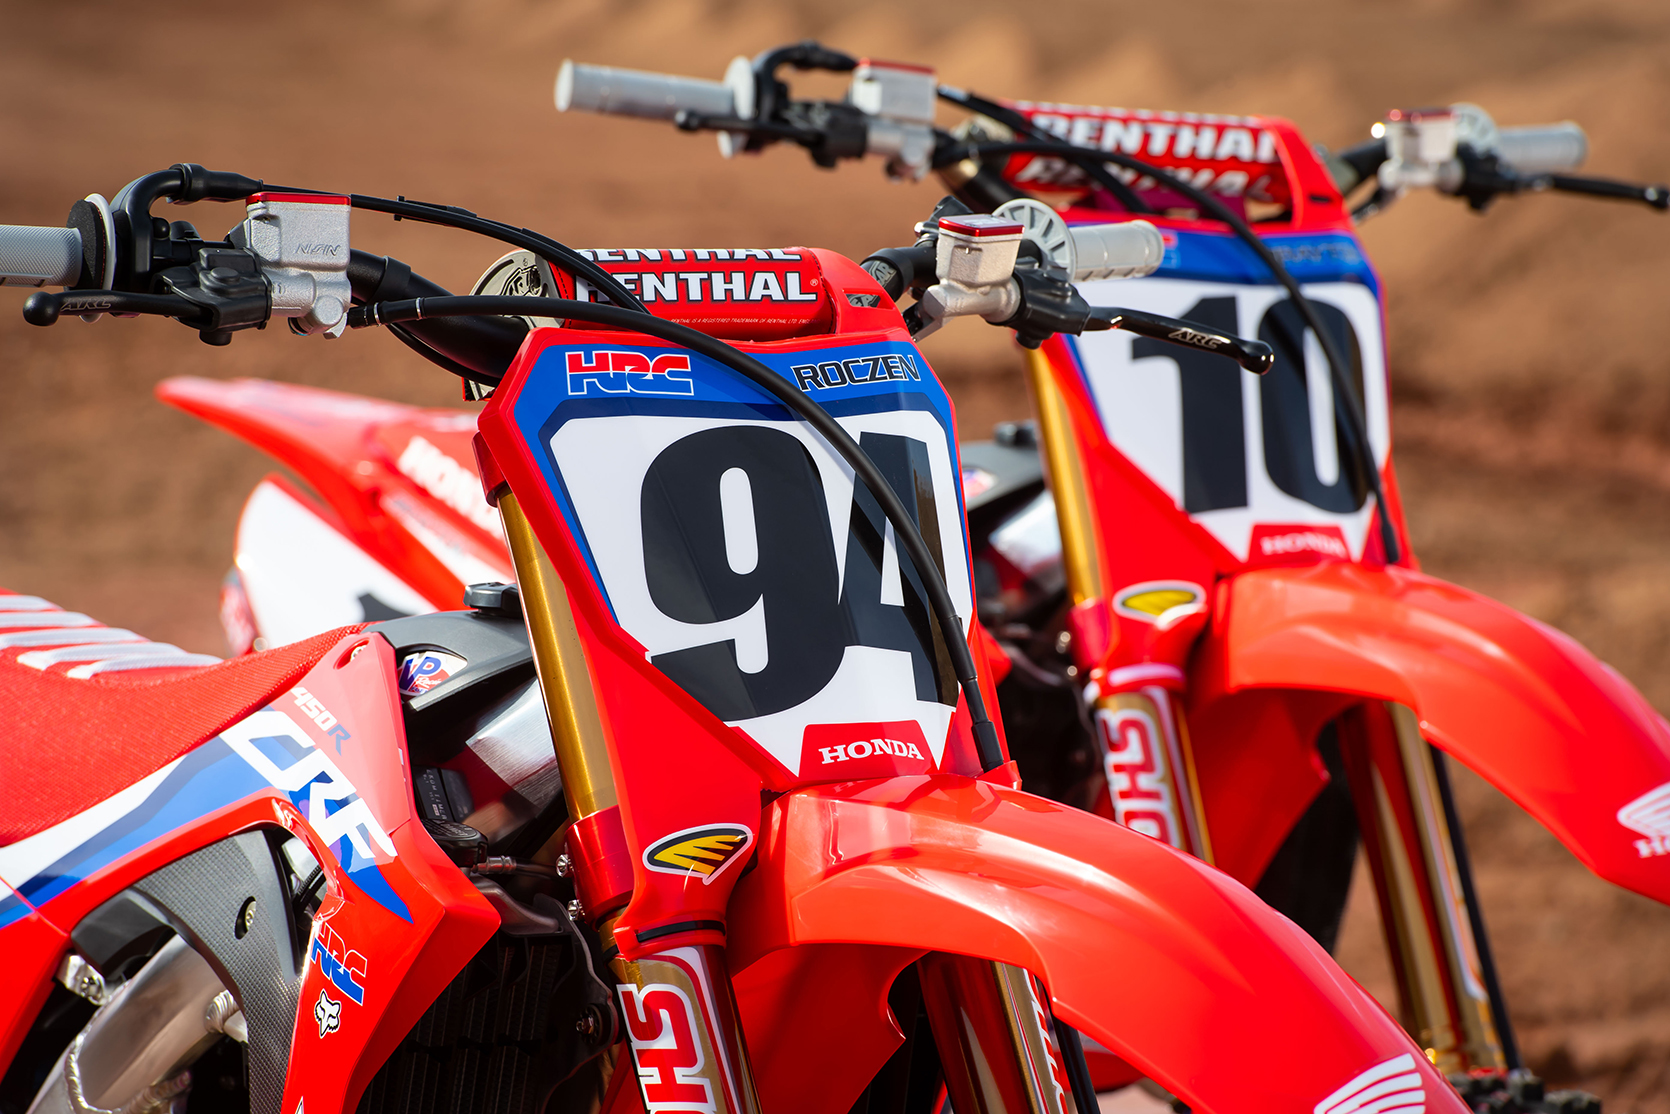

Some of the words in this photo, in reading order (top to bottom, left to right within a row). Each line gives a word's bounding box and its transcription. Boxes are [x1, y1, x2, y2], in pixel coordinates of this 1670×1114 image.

[1168, 326, 1223, 350] ARC
[564, 351, 695, 396] HRC
[790, 354, 922, 392] ROCZEN
[1130, 296, 1370, 515] 10
[640, 425, 959, 723] 94
[398, 656, 442, 691] VP
[818, 738, 925, 765] HONDA
[218, 710, 398, 860] CRF
[310, 918, 368, 1007] HRC
